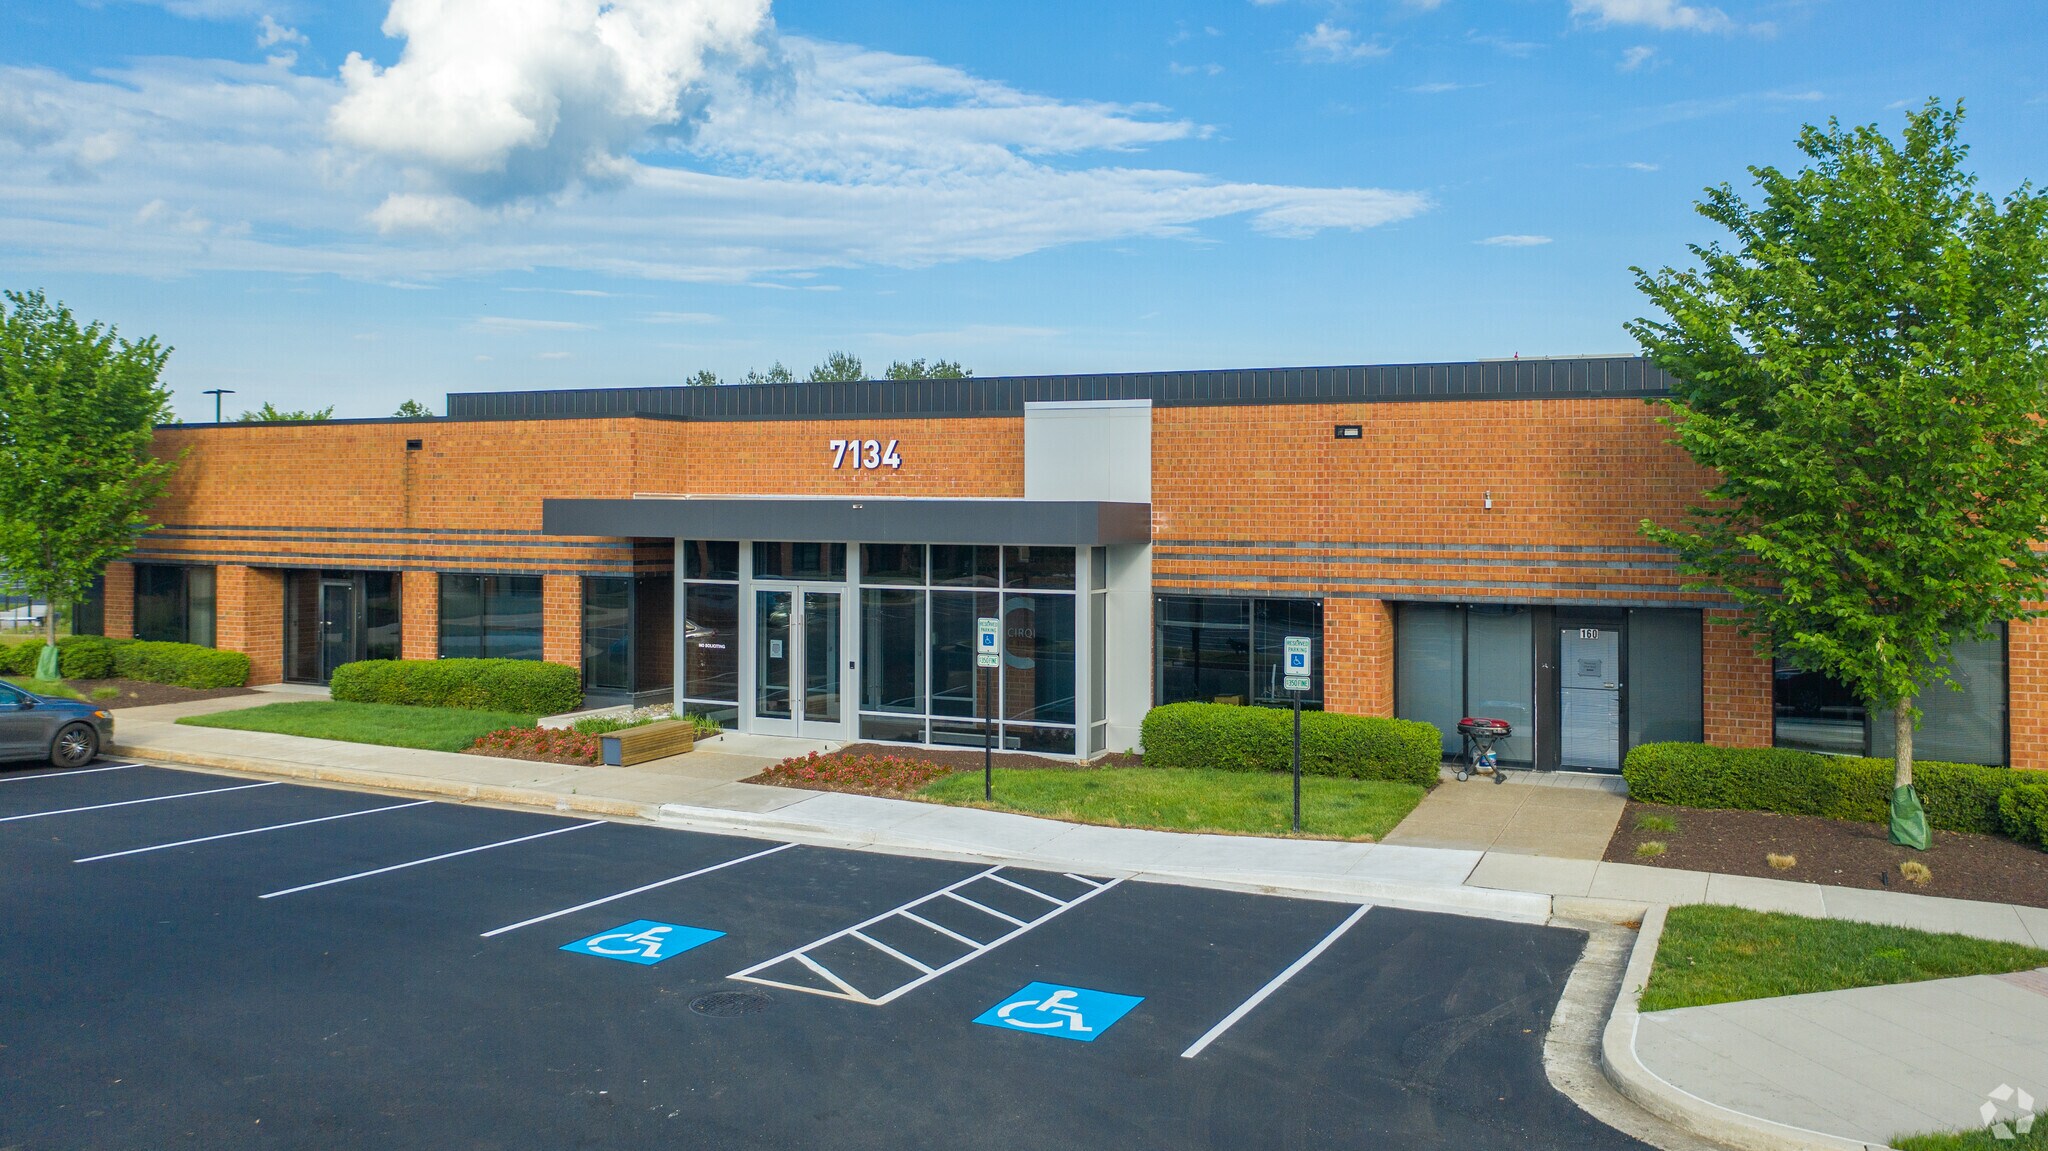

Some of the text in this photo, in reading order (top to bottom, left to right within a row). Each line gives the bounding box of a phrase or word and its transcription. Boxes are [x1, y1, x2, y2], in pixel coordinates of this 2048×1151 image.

[829, 439, 902, 469] 7134
[1581, 629, 1598, 639] 160
[1298, 679, 1308, 687] FINE
